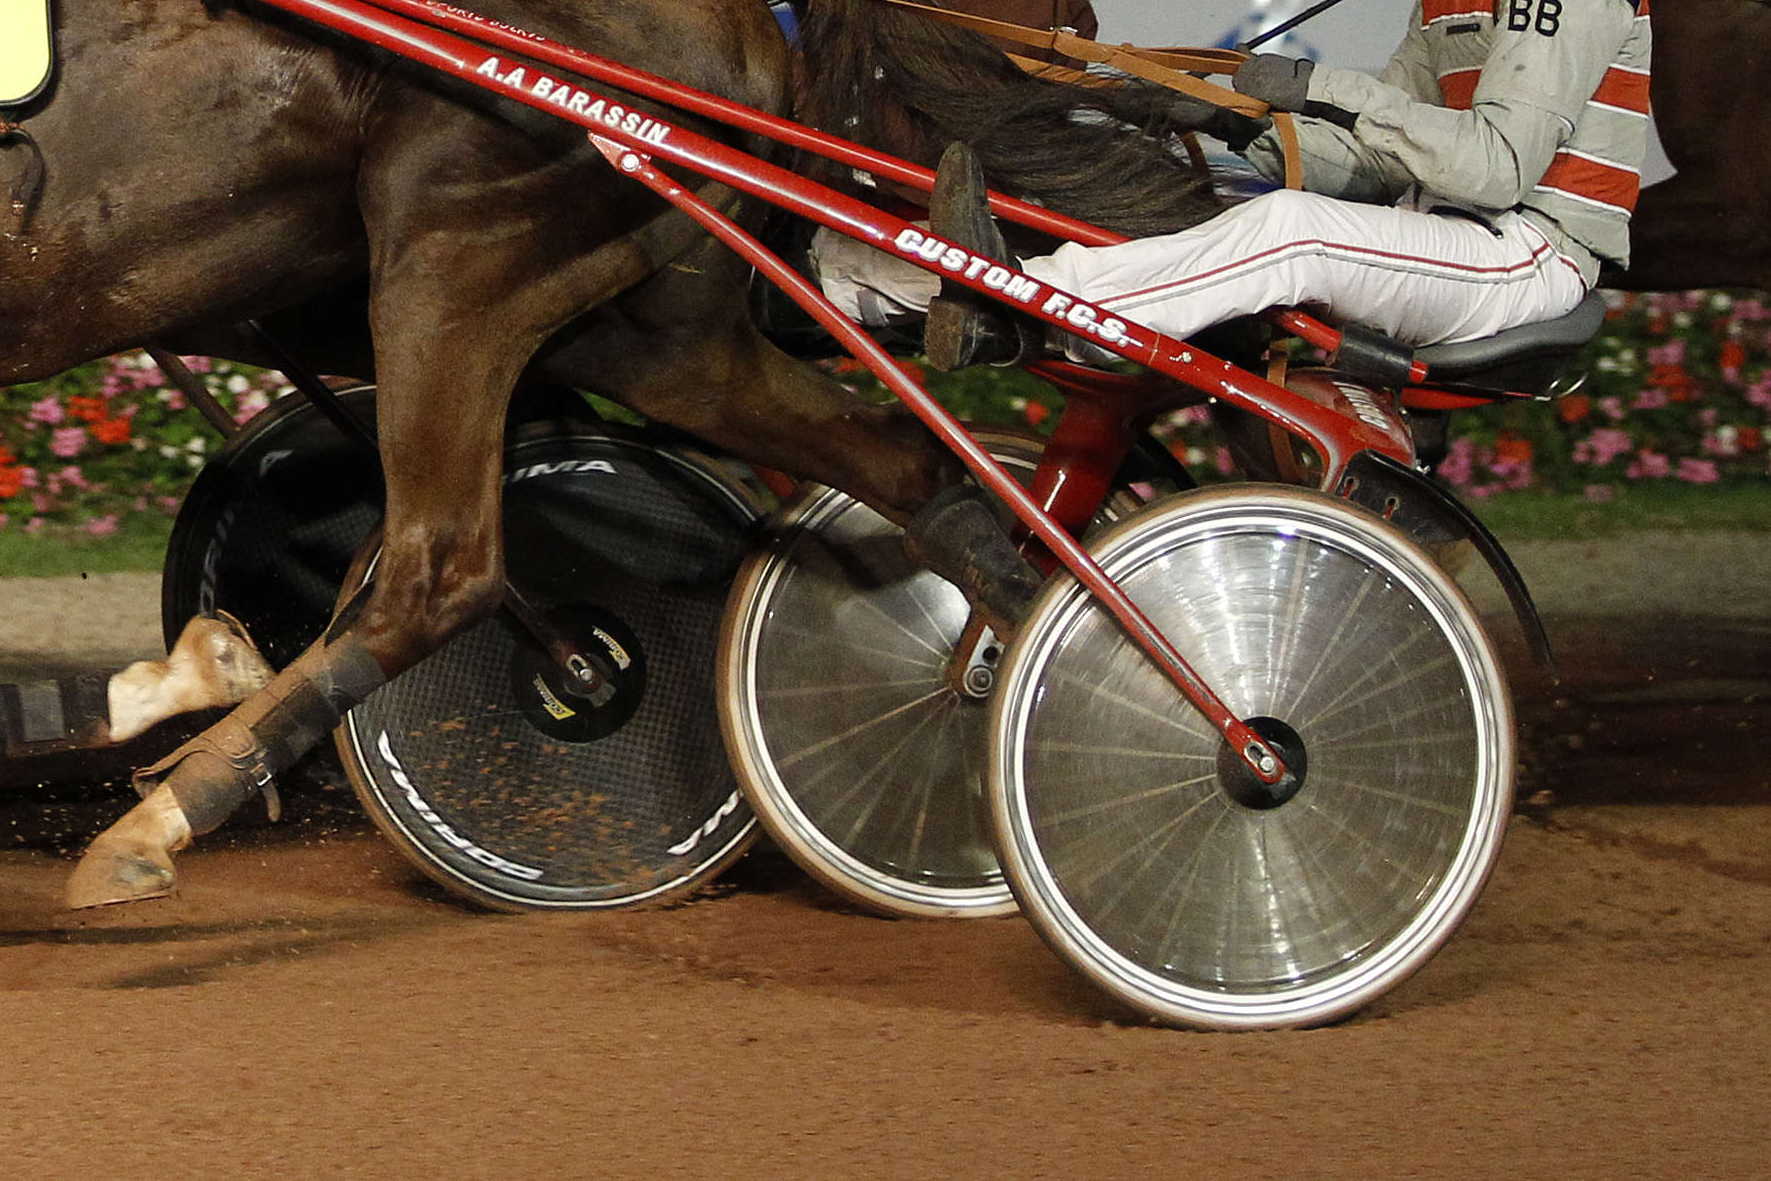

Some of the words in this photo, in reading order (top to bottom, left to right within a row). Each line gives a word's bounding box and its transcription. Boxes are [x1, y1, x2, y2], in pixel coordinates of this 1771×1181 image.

[476, 57, 526, 88] A.A
[530, 76, 671, 143] BARASSIN
[893, 228, 1041, 303] CUSTOM
[377, 729, 544, 880] CORIMA
